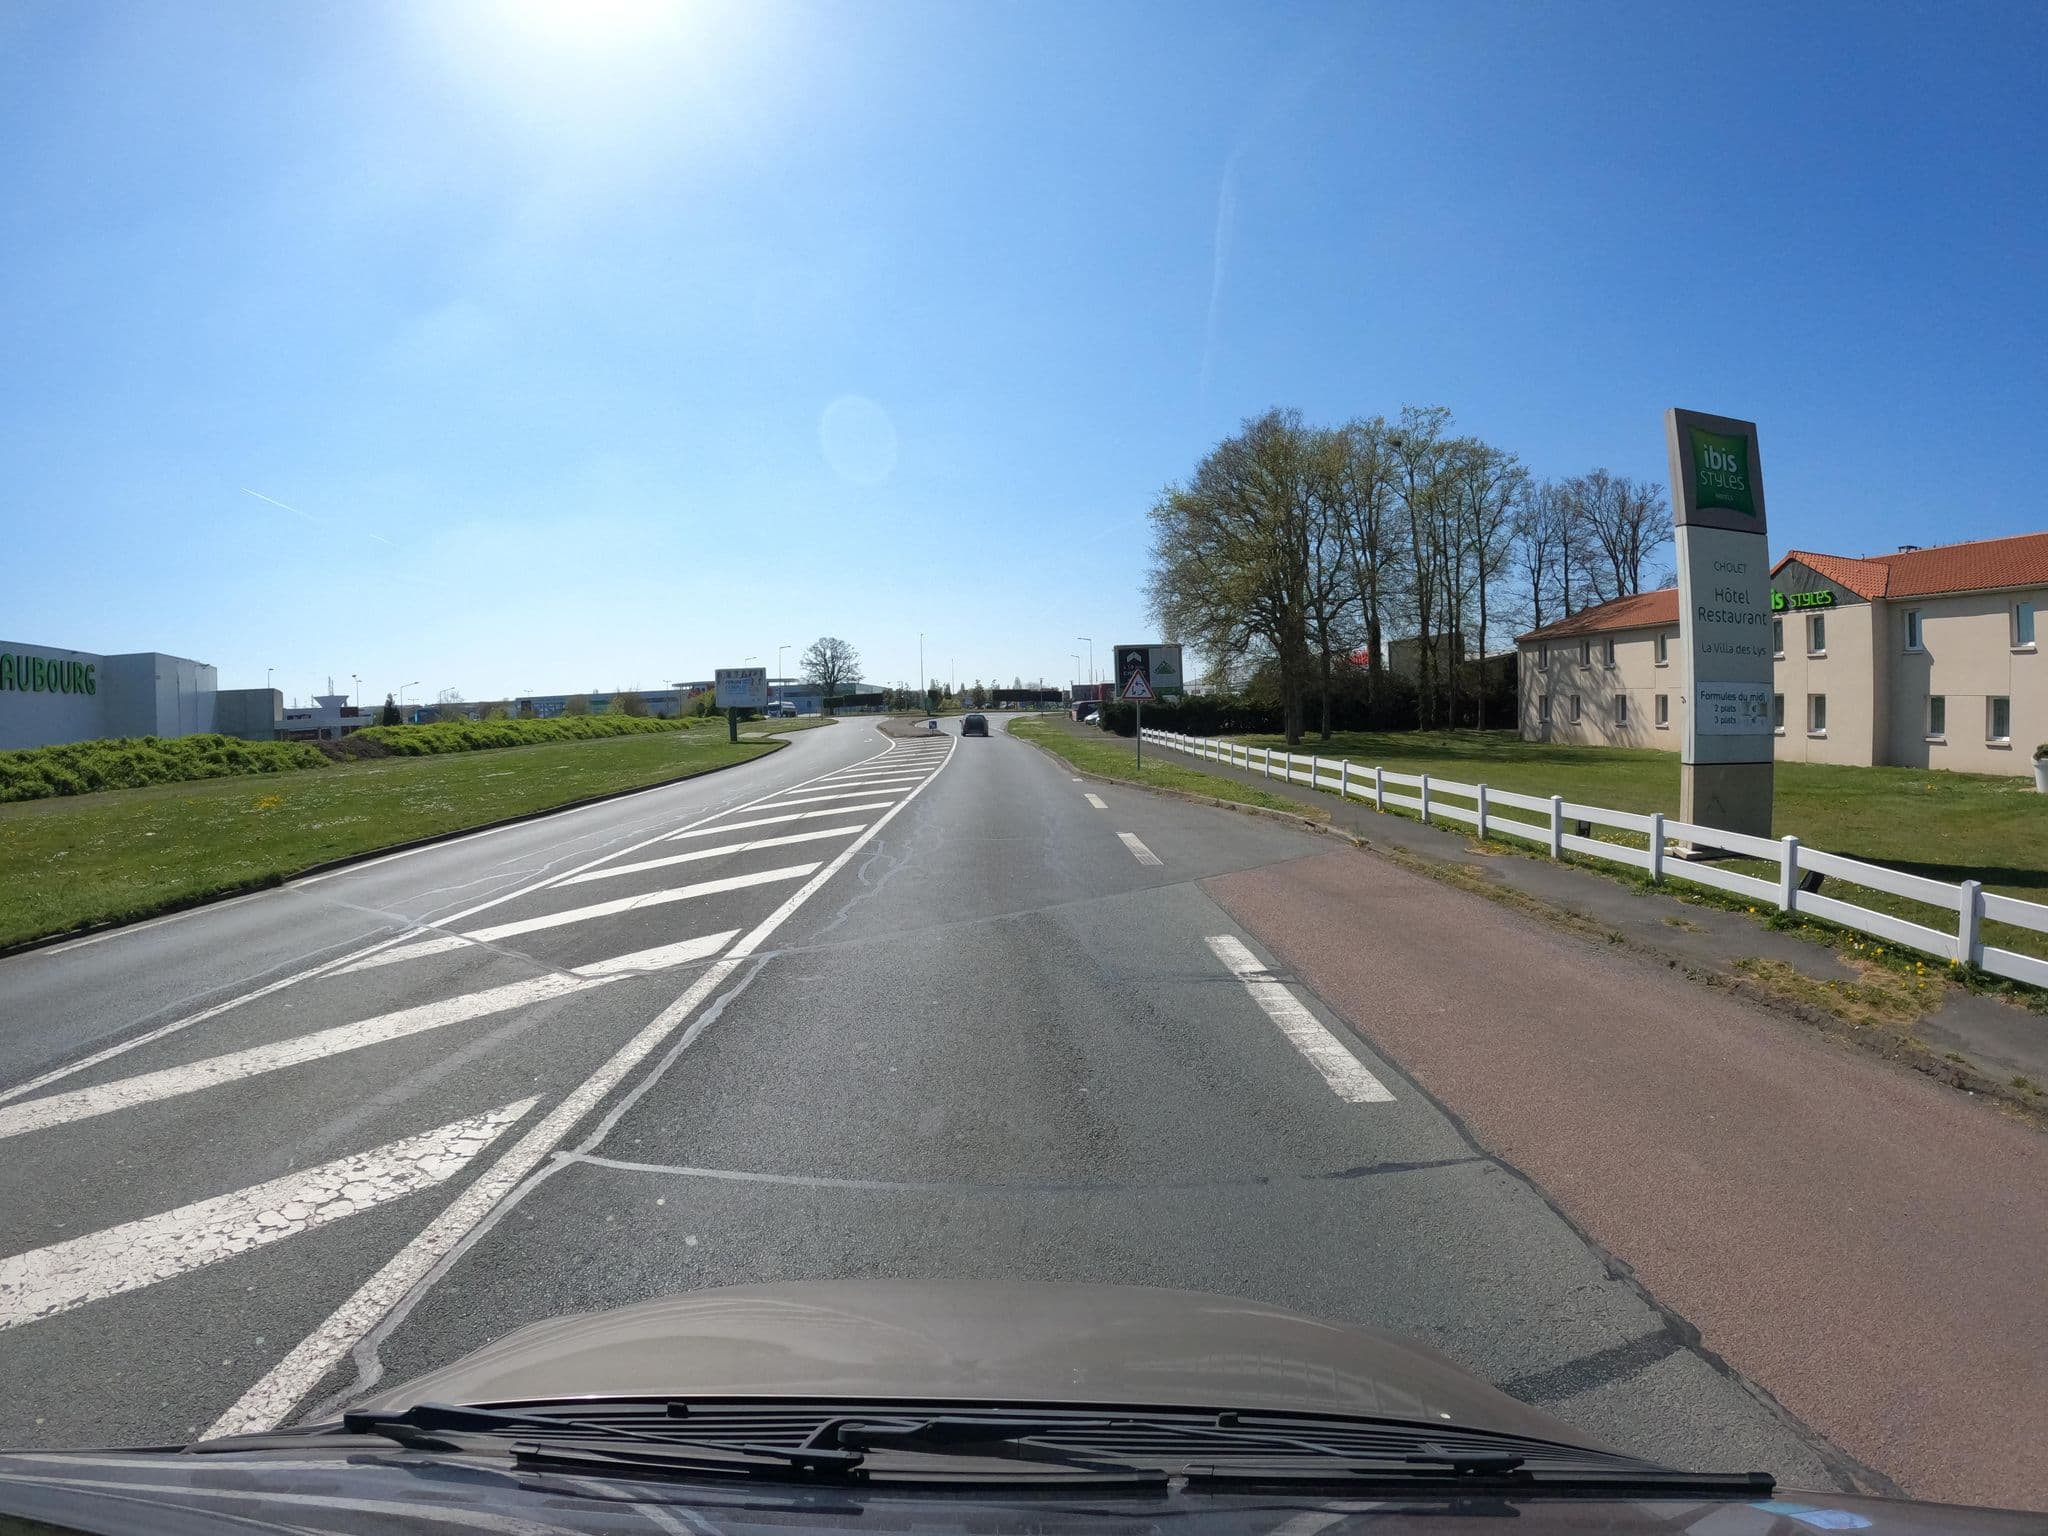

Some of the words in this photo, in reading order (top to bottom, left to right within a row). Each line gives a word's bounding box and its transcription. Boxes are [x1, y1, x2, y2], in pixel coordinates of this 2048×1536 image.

[1703, 443, 1738, 473] ibis
[1713, 561, 1747, 574] CHOLET
[1714, 587, 1750, 605] Hôtel
[1771, 588, 1784, 610] is
[1698, 606, 1768, 626] Restaurant
[1701, 641, 1712, 653] La
[1713, 642, 1734, 654] Villa
[1735, 644, 1751, 655] des
[1752, 645, 1767, 657] Lys
[0, 652, 97, 696] AUBOURG
[1700, 691, 1737, 701] Formules
[1738, 692, 1748, 702] du
[1750, 692, 1766, 702] midi
[1720, 704, 1737, 713] plats
[1720, 716, 1737, 725] plats
